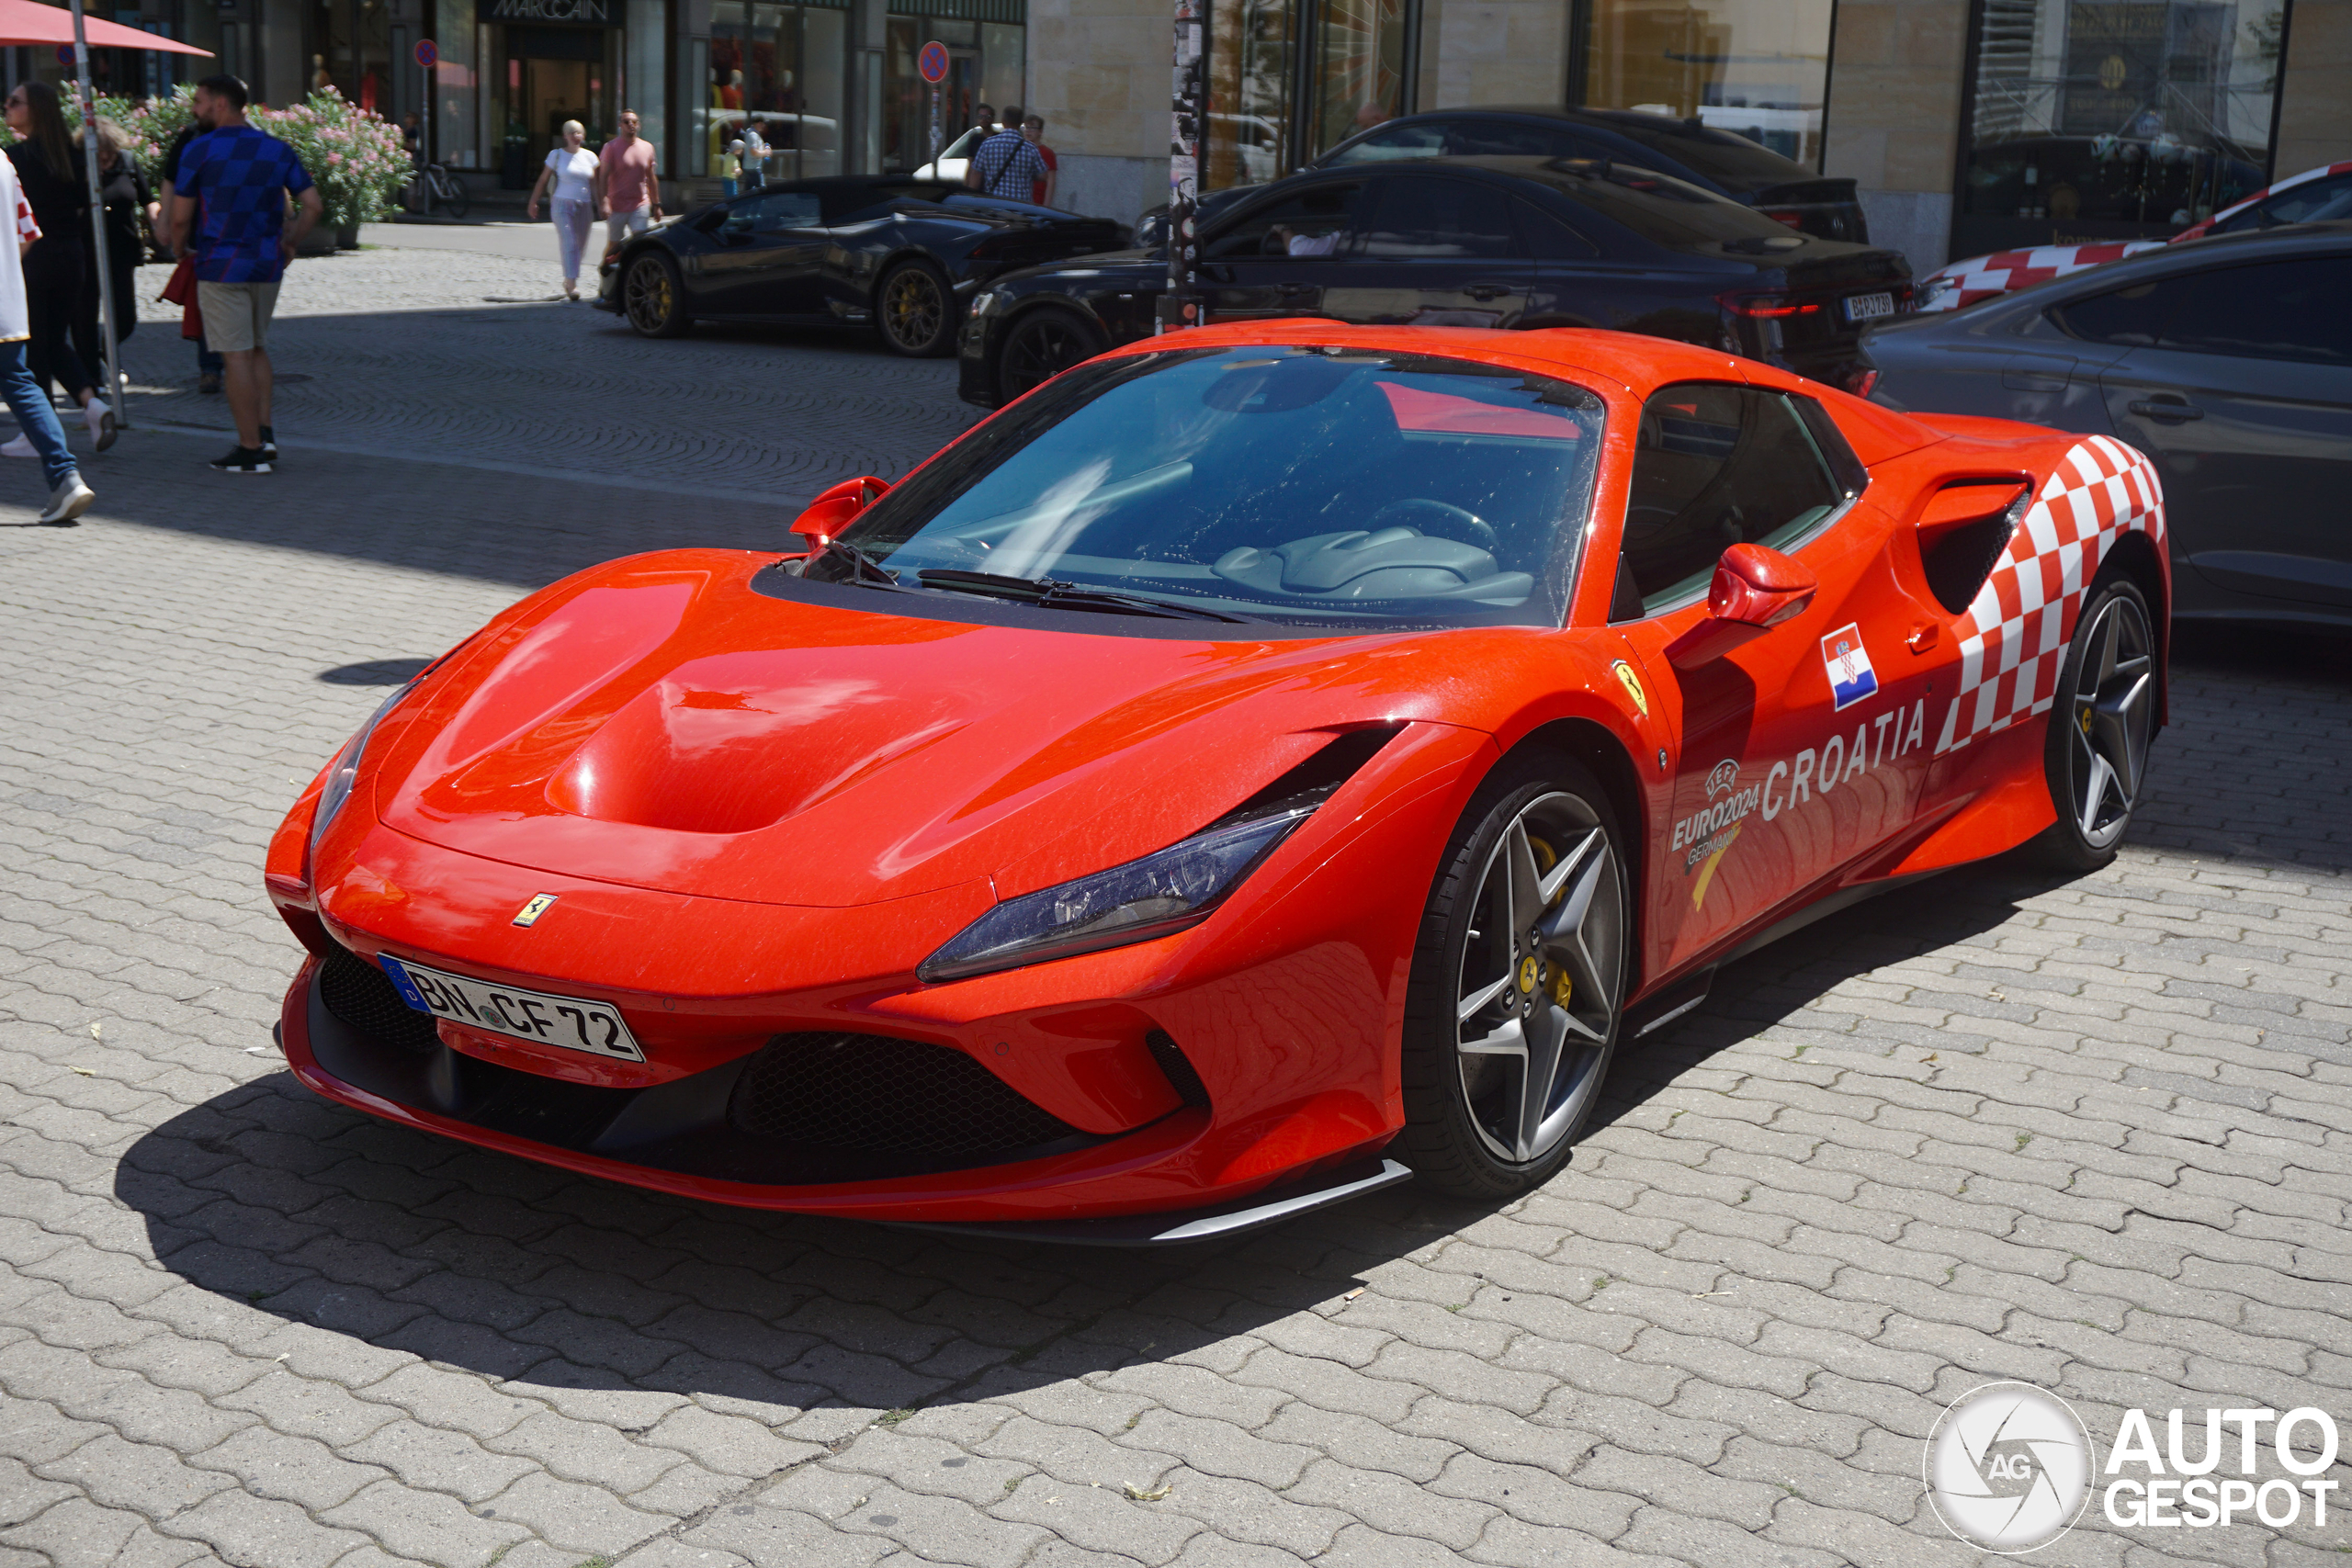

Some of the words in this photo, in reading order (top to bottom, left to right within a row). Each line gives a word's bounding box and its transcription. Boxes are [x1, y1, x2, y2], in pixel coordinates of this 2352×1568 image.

[1851, 299, 1860, 317] B
[1762, 698, 1924, 821] CROATIA
[1706, 764, 1736, 796] UEFA
[1688, 826, 1737, 865] GERMANY
[407, 988, 419, 1002] D
[407, 970, 481, 1021] BN
[489, 992, 554, 1038] CF
[556, 1005, 635, 1055] 72
